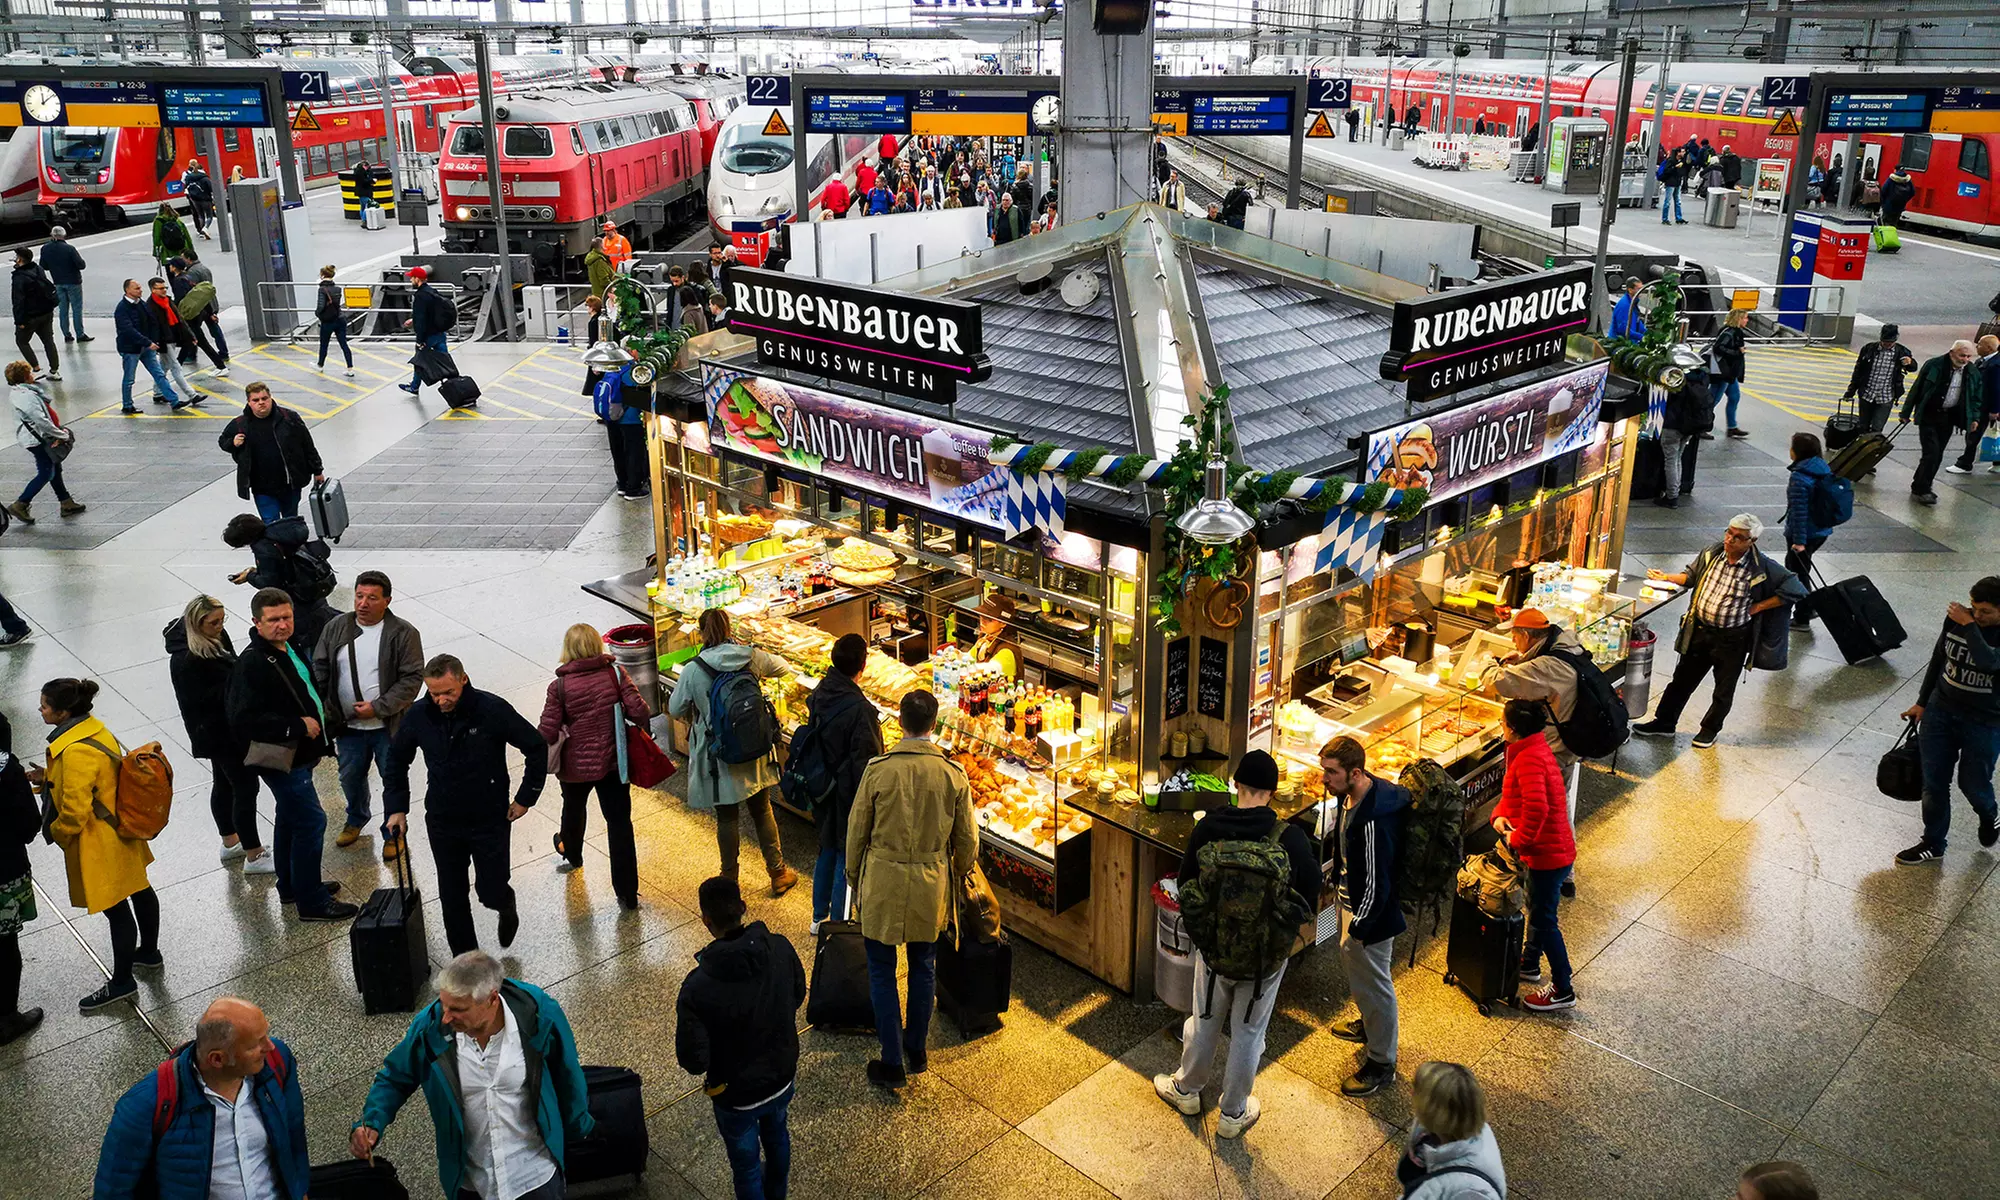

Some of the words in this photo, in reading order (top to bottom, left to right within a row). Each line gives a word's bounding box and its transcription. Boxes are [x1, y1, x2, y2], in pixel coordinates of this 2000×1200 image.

[127, 81, 147, 89] 22-36
[299, 72, 322, 94] 21
[751, 77, 778, 99] 22
[920, 89, 934, 97] 5-21
[1320, 80, 1347, 102] 23
[1769, 78, 1796, 100] 24
[1945, 87, 1960, 95] 5-23
[1212, 105, 1256, 113] Hamburg-Altona
[1764, 137, 1784, 150] REGIO
[455, 163, 478, 171] 424-0
[763, 339, 933, 391] GENUSSWELTEN
[1431, 338, 1563, 389] GENUSSWELTEN
[772, 403, 925, 487] SANDWICH
[952, 437, 977, 456] Coffee
[977, 444, 987, 458] to
[1448, 408, 1535, 479] WÜRSTL
[1961, 668, 1994, 687] YORK
